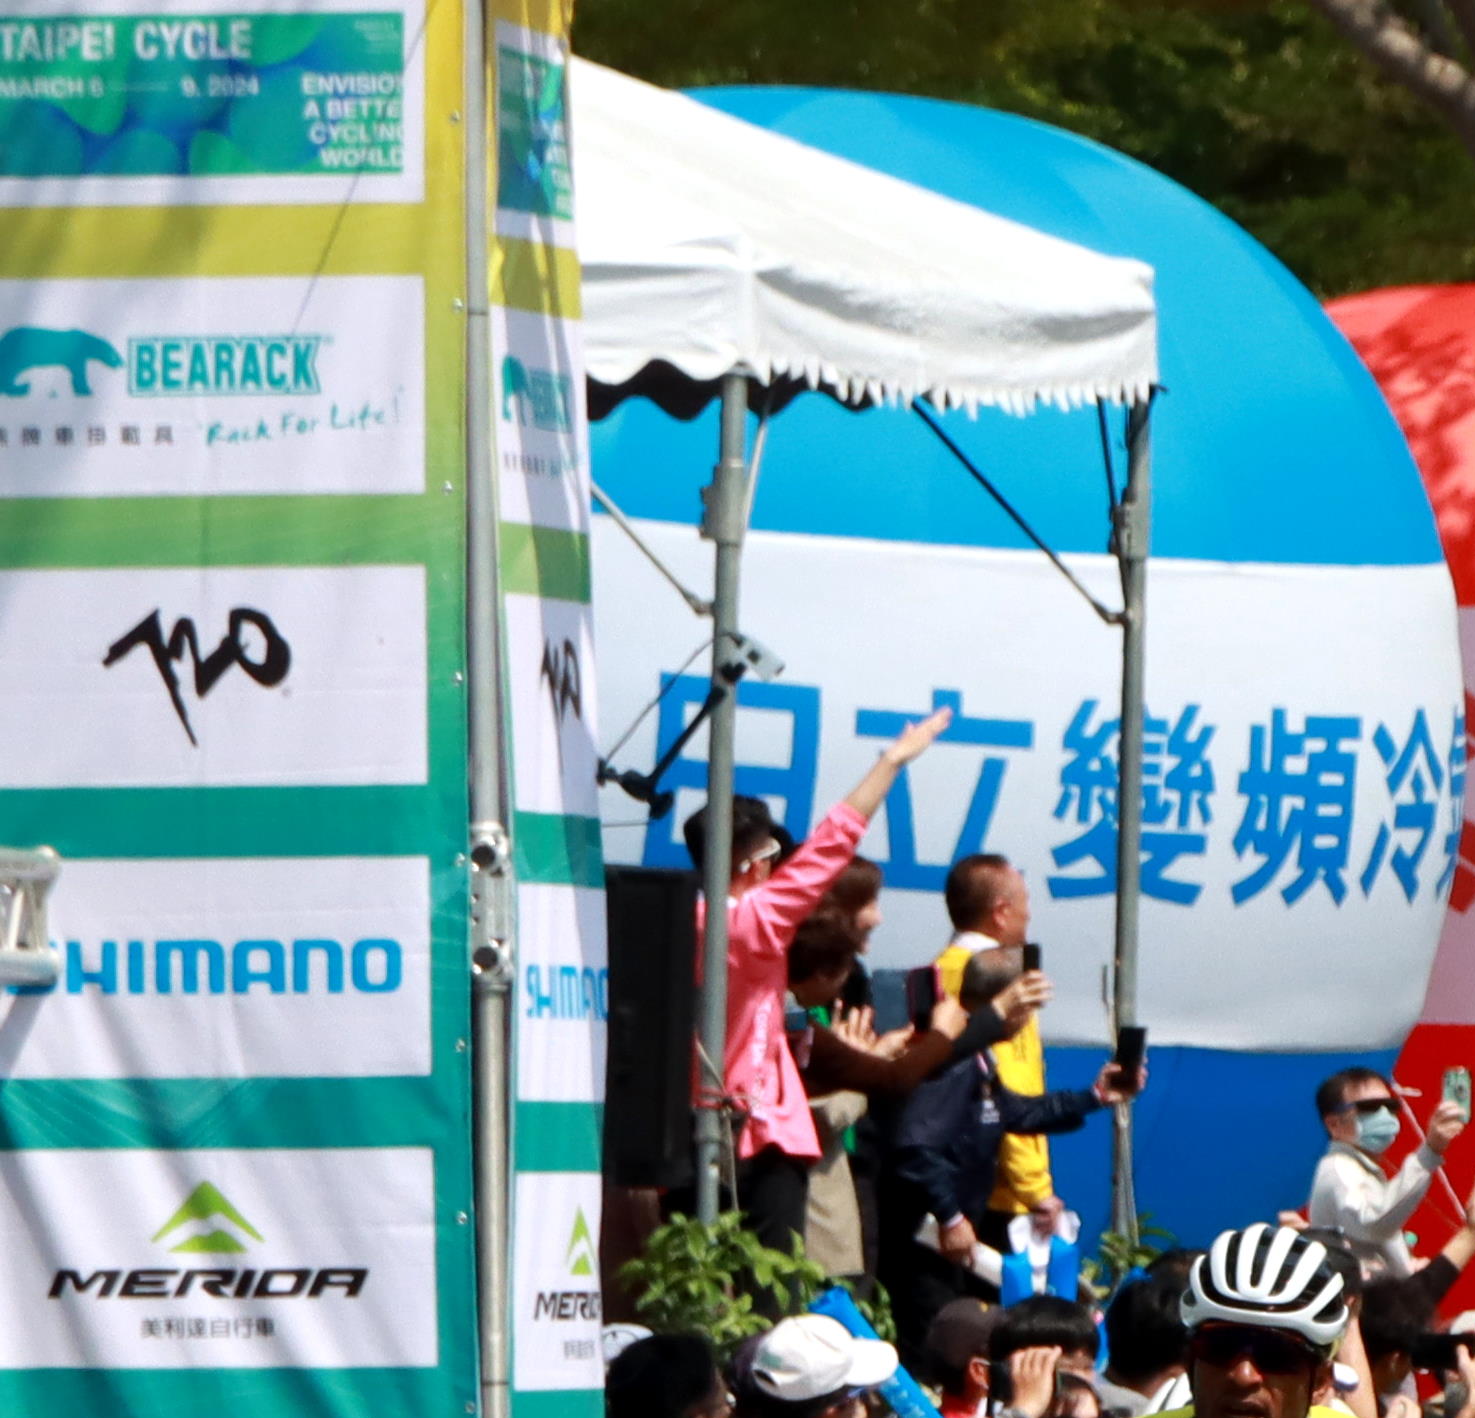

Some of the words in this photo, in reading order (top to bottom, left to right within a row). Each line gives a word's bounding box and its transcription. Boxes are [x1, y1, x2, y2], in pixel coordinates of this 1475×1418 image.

[1, 21, 114, 60] TAIPEI
[134, 20, 252, 60] CYCLE
[302, 72, 402, 95] ENVISIO
[134, 342, 315, 391] BEARACK
[643, 671, 1466, 909] 日立變頻冷
[47, 1268, 368, 1299] MERIDA
